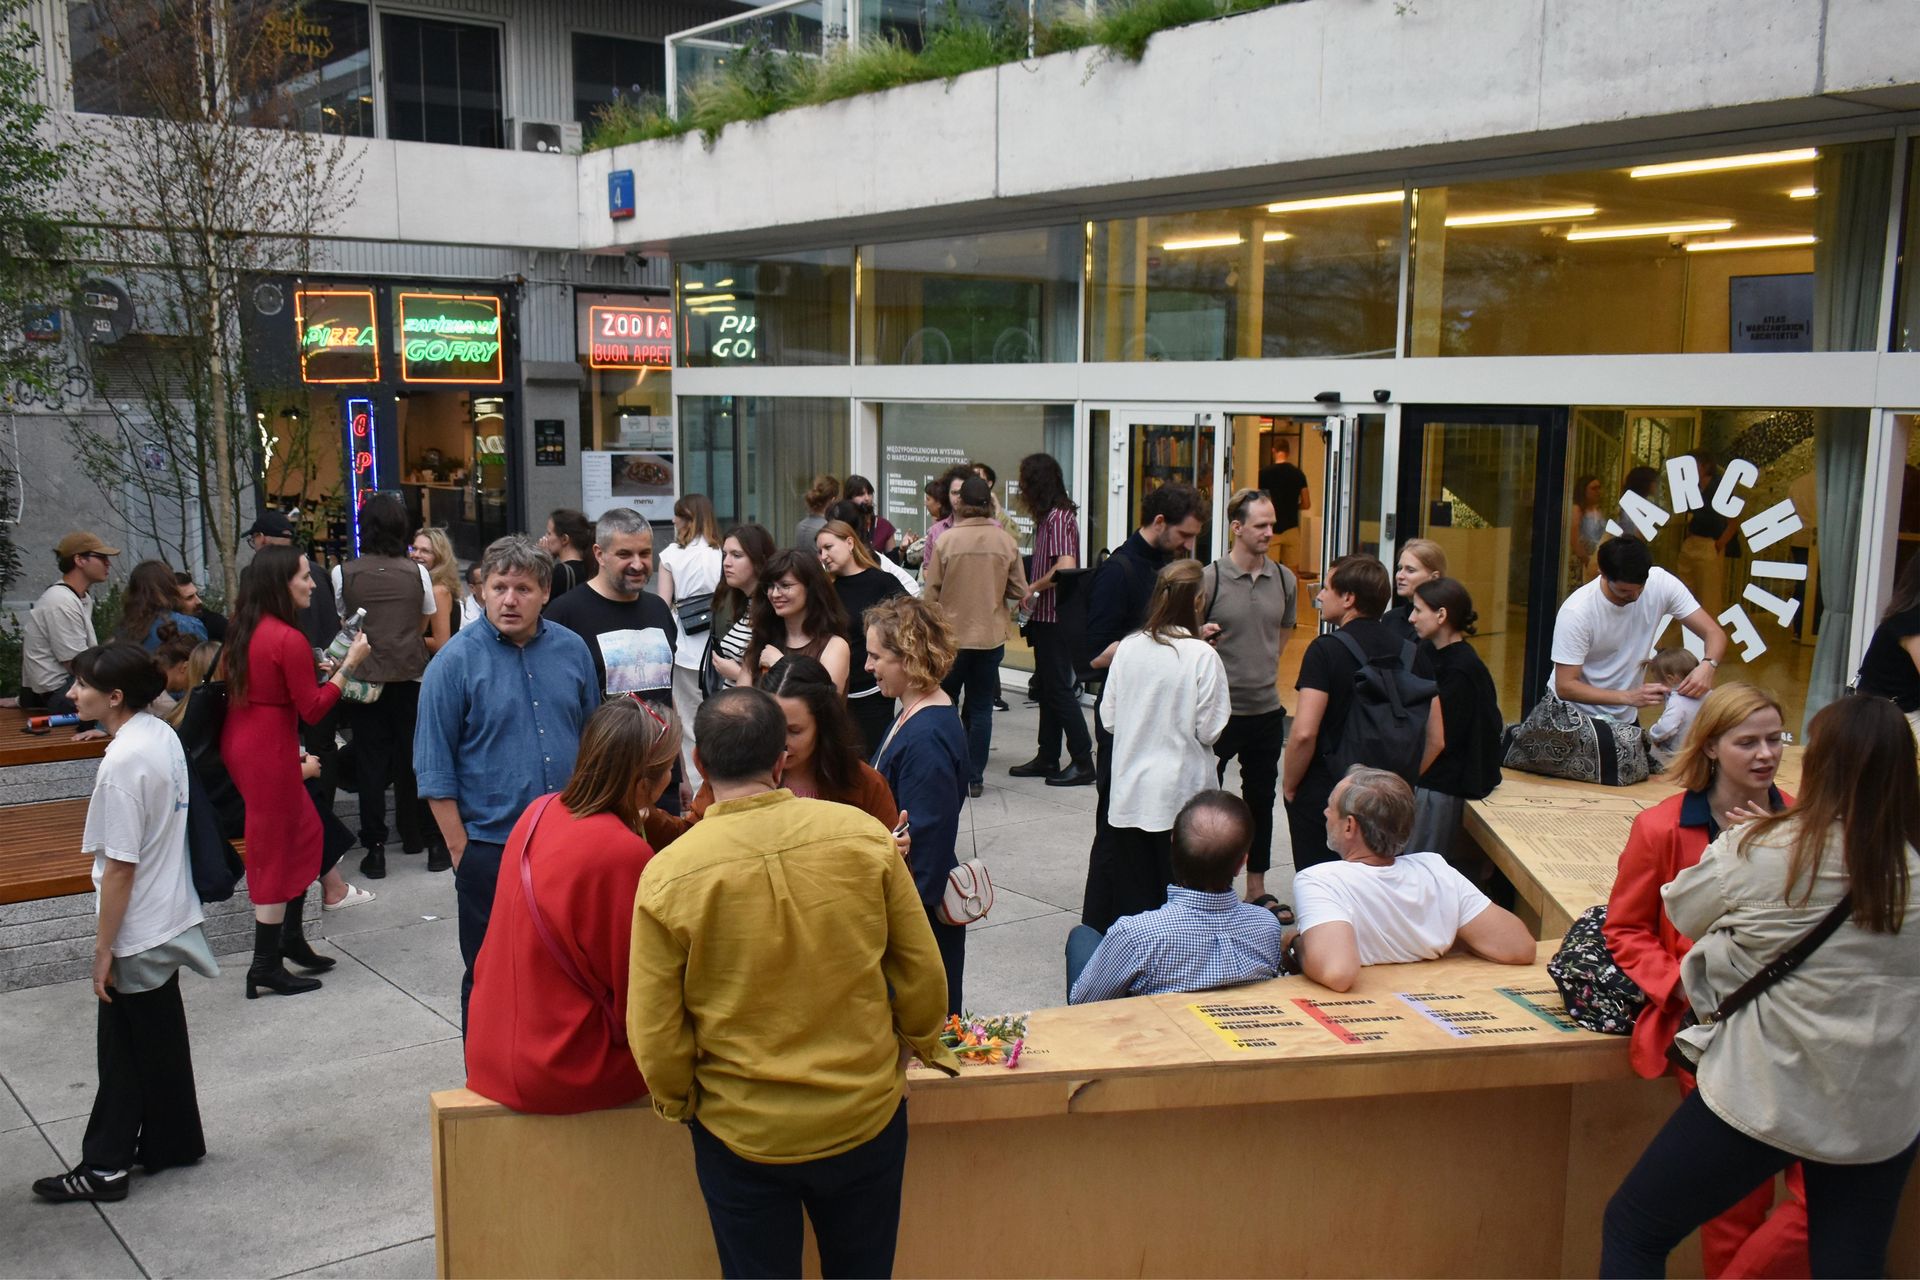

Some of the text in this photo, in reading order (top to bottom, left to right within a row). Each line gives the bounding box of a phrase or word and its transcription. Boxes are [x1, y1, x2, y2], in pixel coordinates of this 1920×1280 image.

[614, 186, 623, 209] 4
[601, 312, 672, 339] ZODIA
[303, 325, 376, 348] PIZZA
[405, 339, 500, 363] GOFRY
[594, 343, 672, 364] BUON APPET
[939, 448, 965, 456] WYSTAWA
[1307, 999, 1376, 1008] JANKOWSKA
[1217, 1021, 1304, 1030] WASILKOWSKA
[1326, 1015, 1405, 1025] PASZKOWSKA
